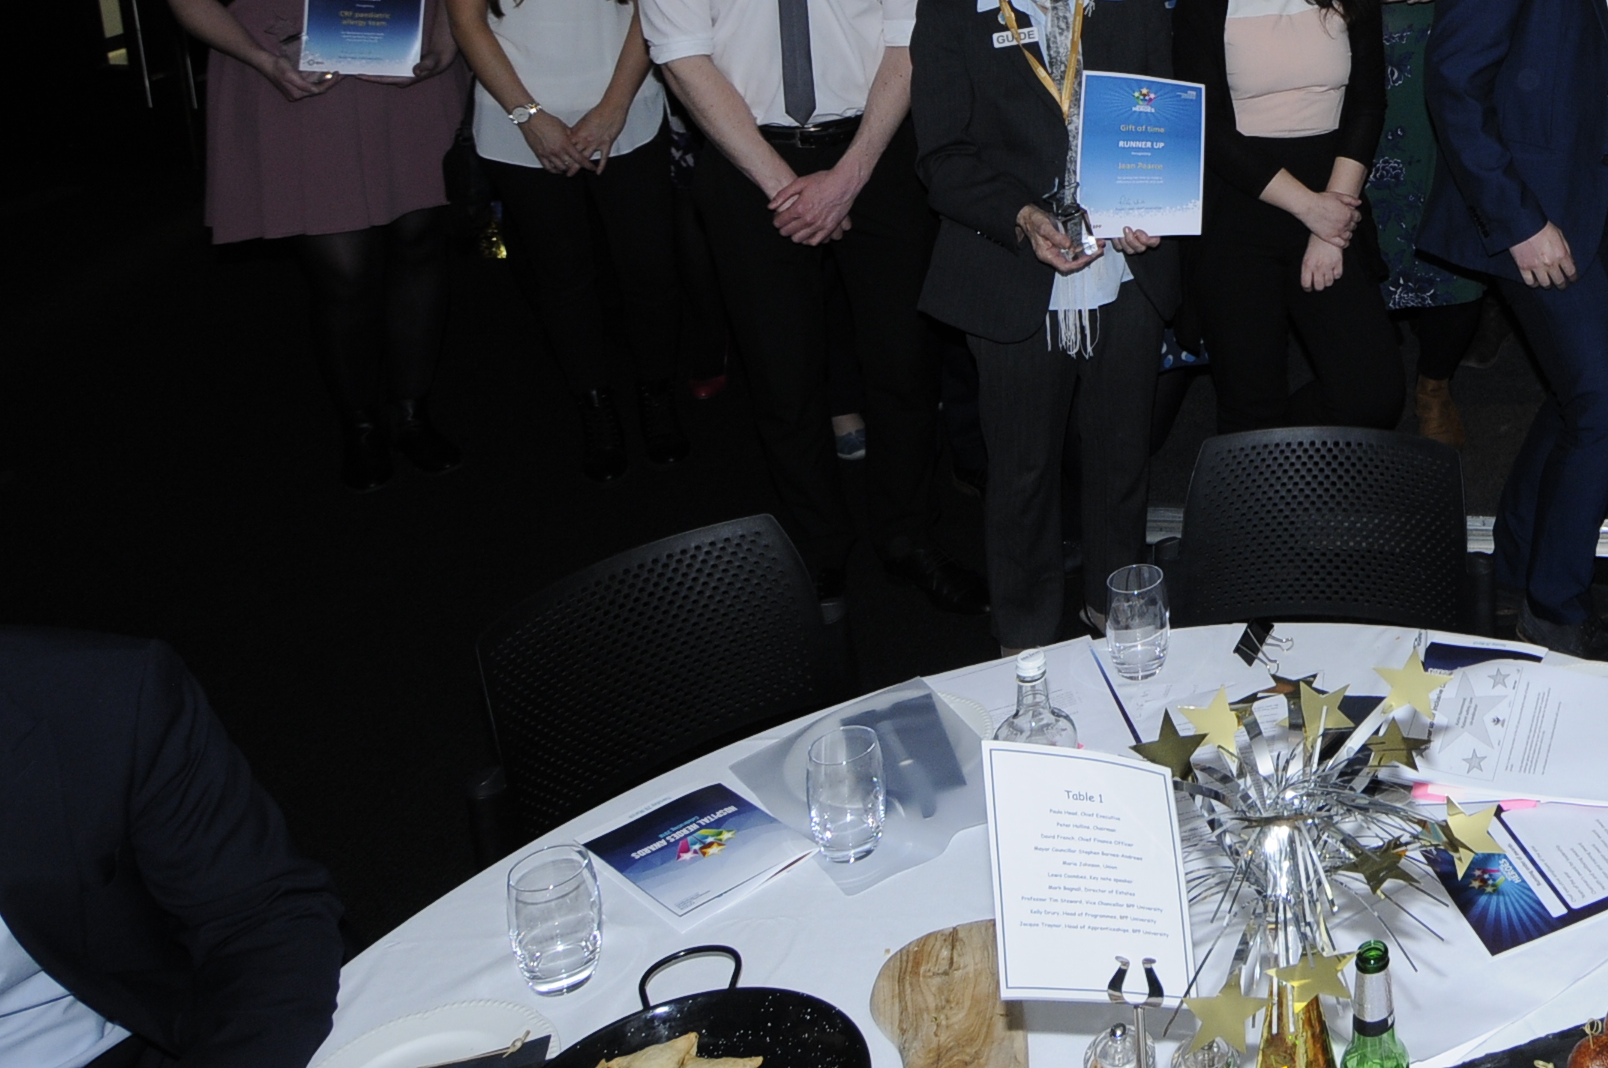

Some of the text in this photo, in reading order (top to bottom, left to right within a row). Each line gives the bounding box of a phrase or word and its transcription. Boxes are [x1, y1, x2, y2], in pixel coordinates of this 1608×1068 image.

[996, 30, 1035, 44] GUDE
[1120, 124, 1135, 132] Gift
[1064, 790, 1103, 803] Table 1
[630, 804, 737, 860] HOSPITAL HEROES AWARDS
[1499, 857, 1521, 883] HEROES
[1520, 860, 1529, 871] order
[1528, 870, 1541, 886] Running
